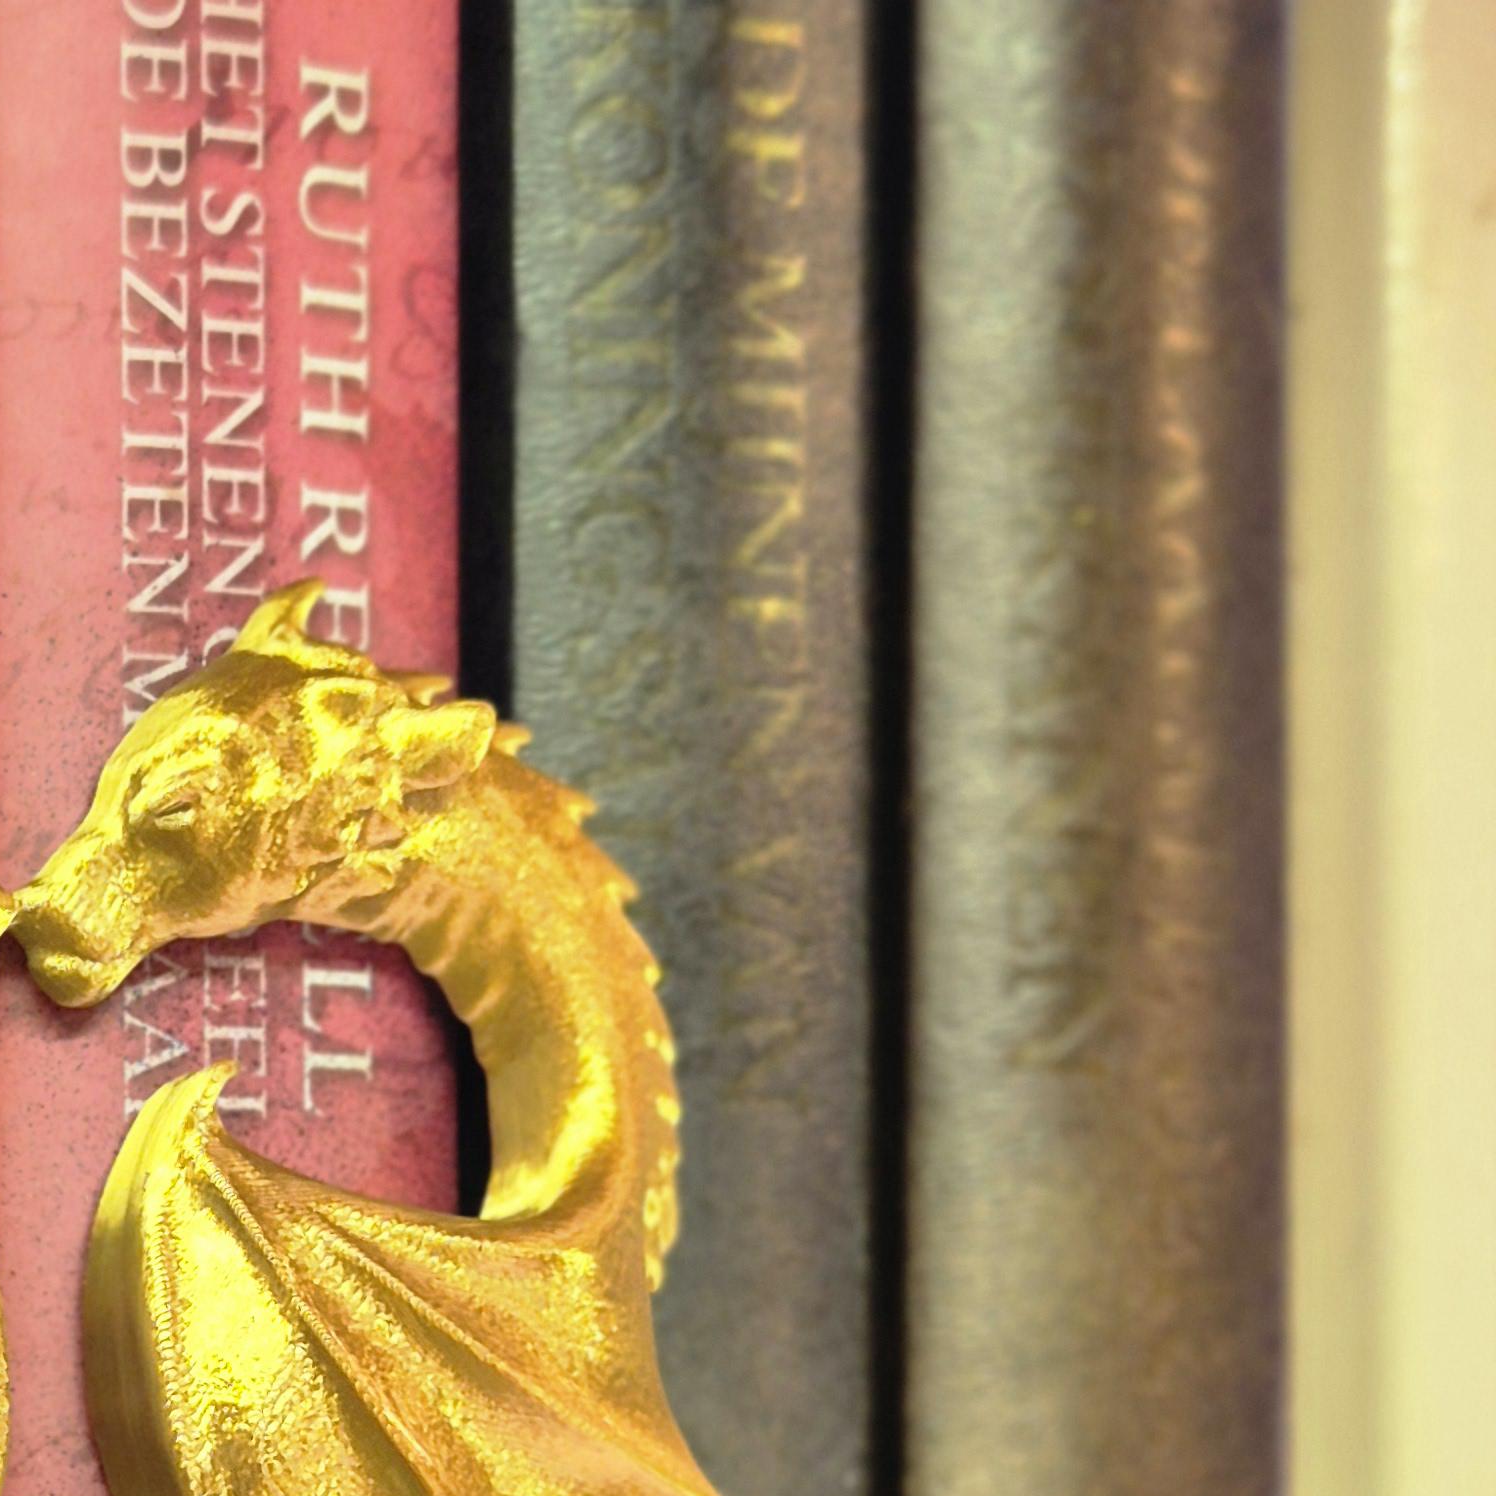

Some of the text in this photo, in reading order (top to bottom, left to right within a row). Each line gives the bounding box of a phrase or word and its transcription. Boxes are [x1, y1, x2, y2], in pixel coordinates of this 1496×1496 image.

[120, 126, 191, 622] BEZETEN
[200, 186, 268, 601] STENEN
[297, 54, 374, 1118] RUTH RELL
